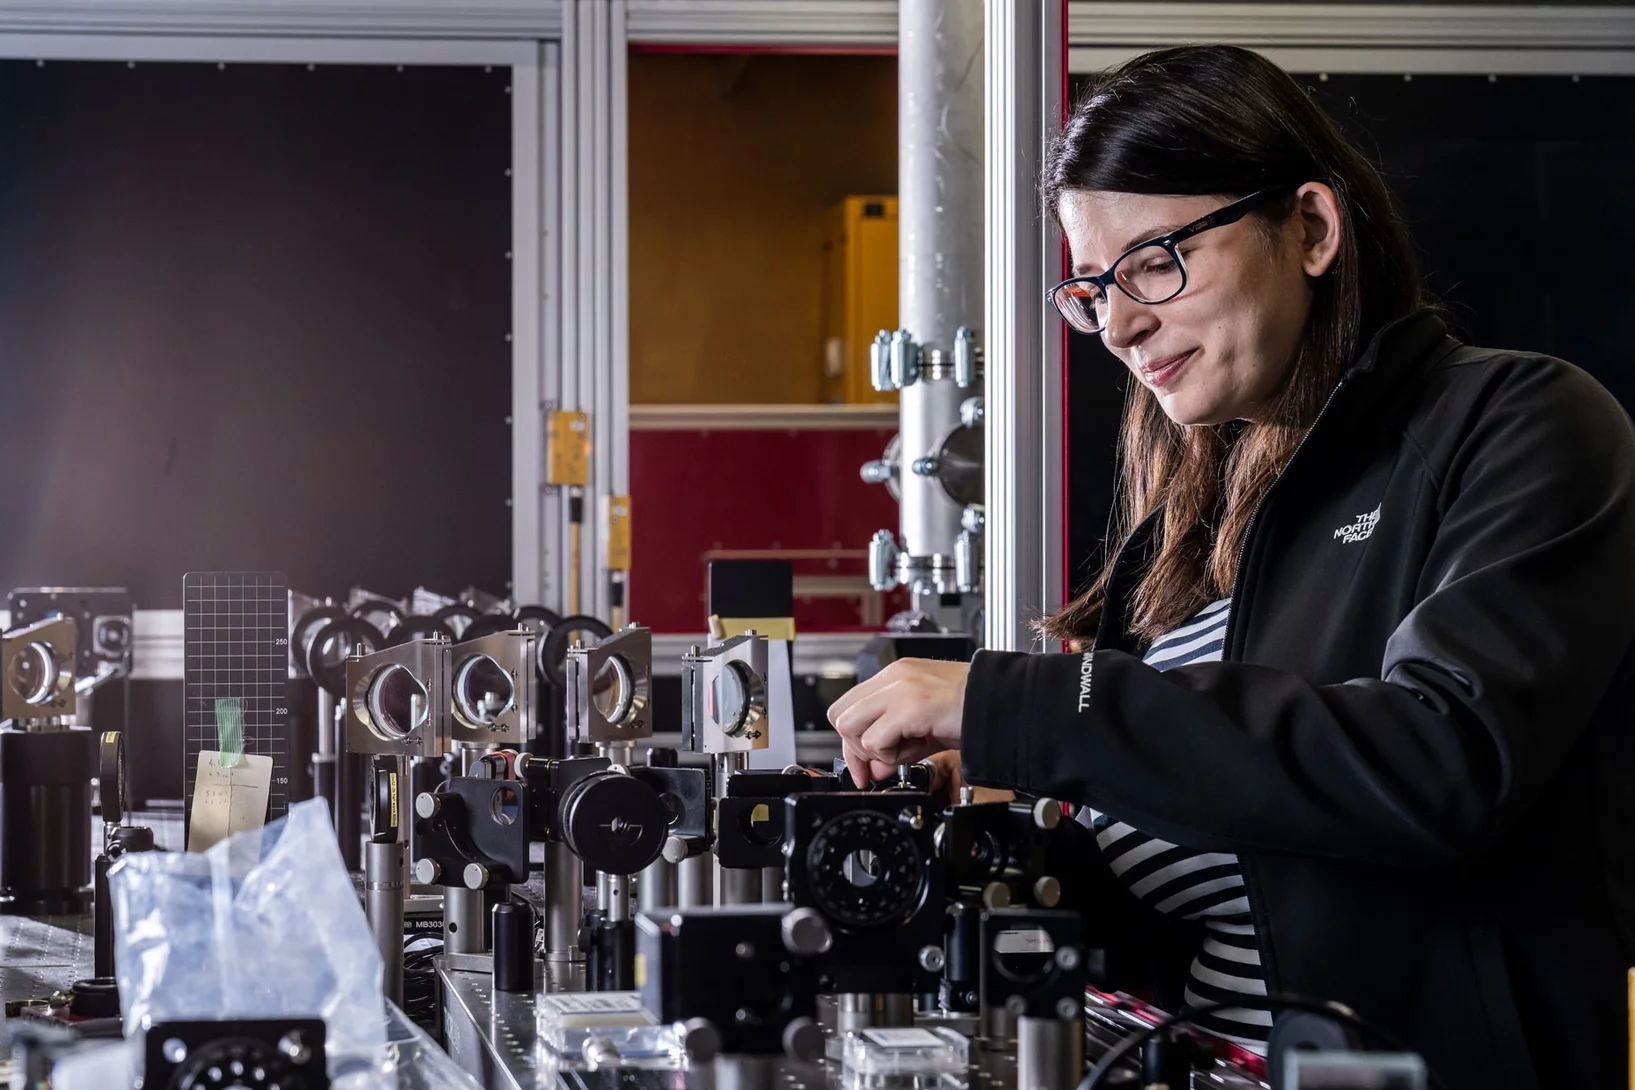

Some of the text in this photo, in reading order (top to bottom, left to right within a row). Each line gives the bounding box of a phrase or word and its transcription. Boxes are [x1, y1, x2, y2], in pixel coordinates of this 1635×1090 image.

[1355, 510, 1377, 523] THE
[1333, 521, 1375, 540] NORTH
[1342, 530, 1373, 544] FACE
